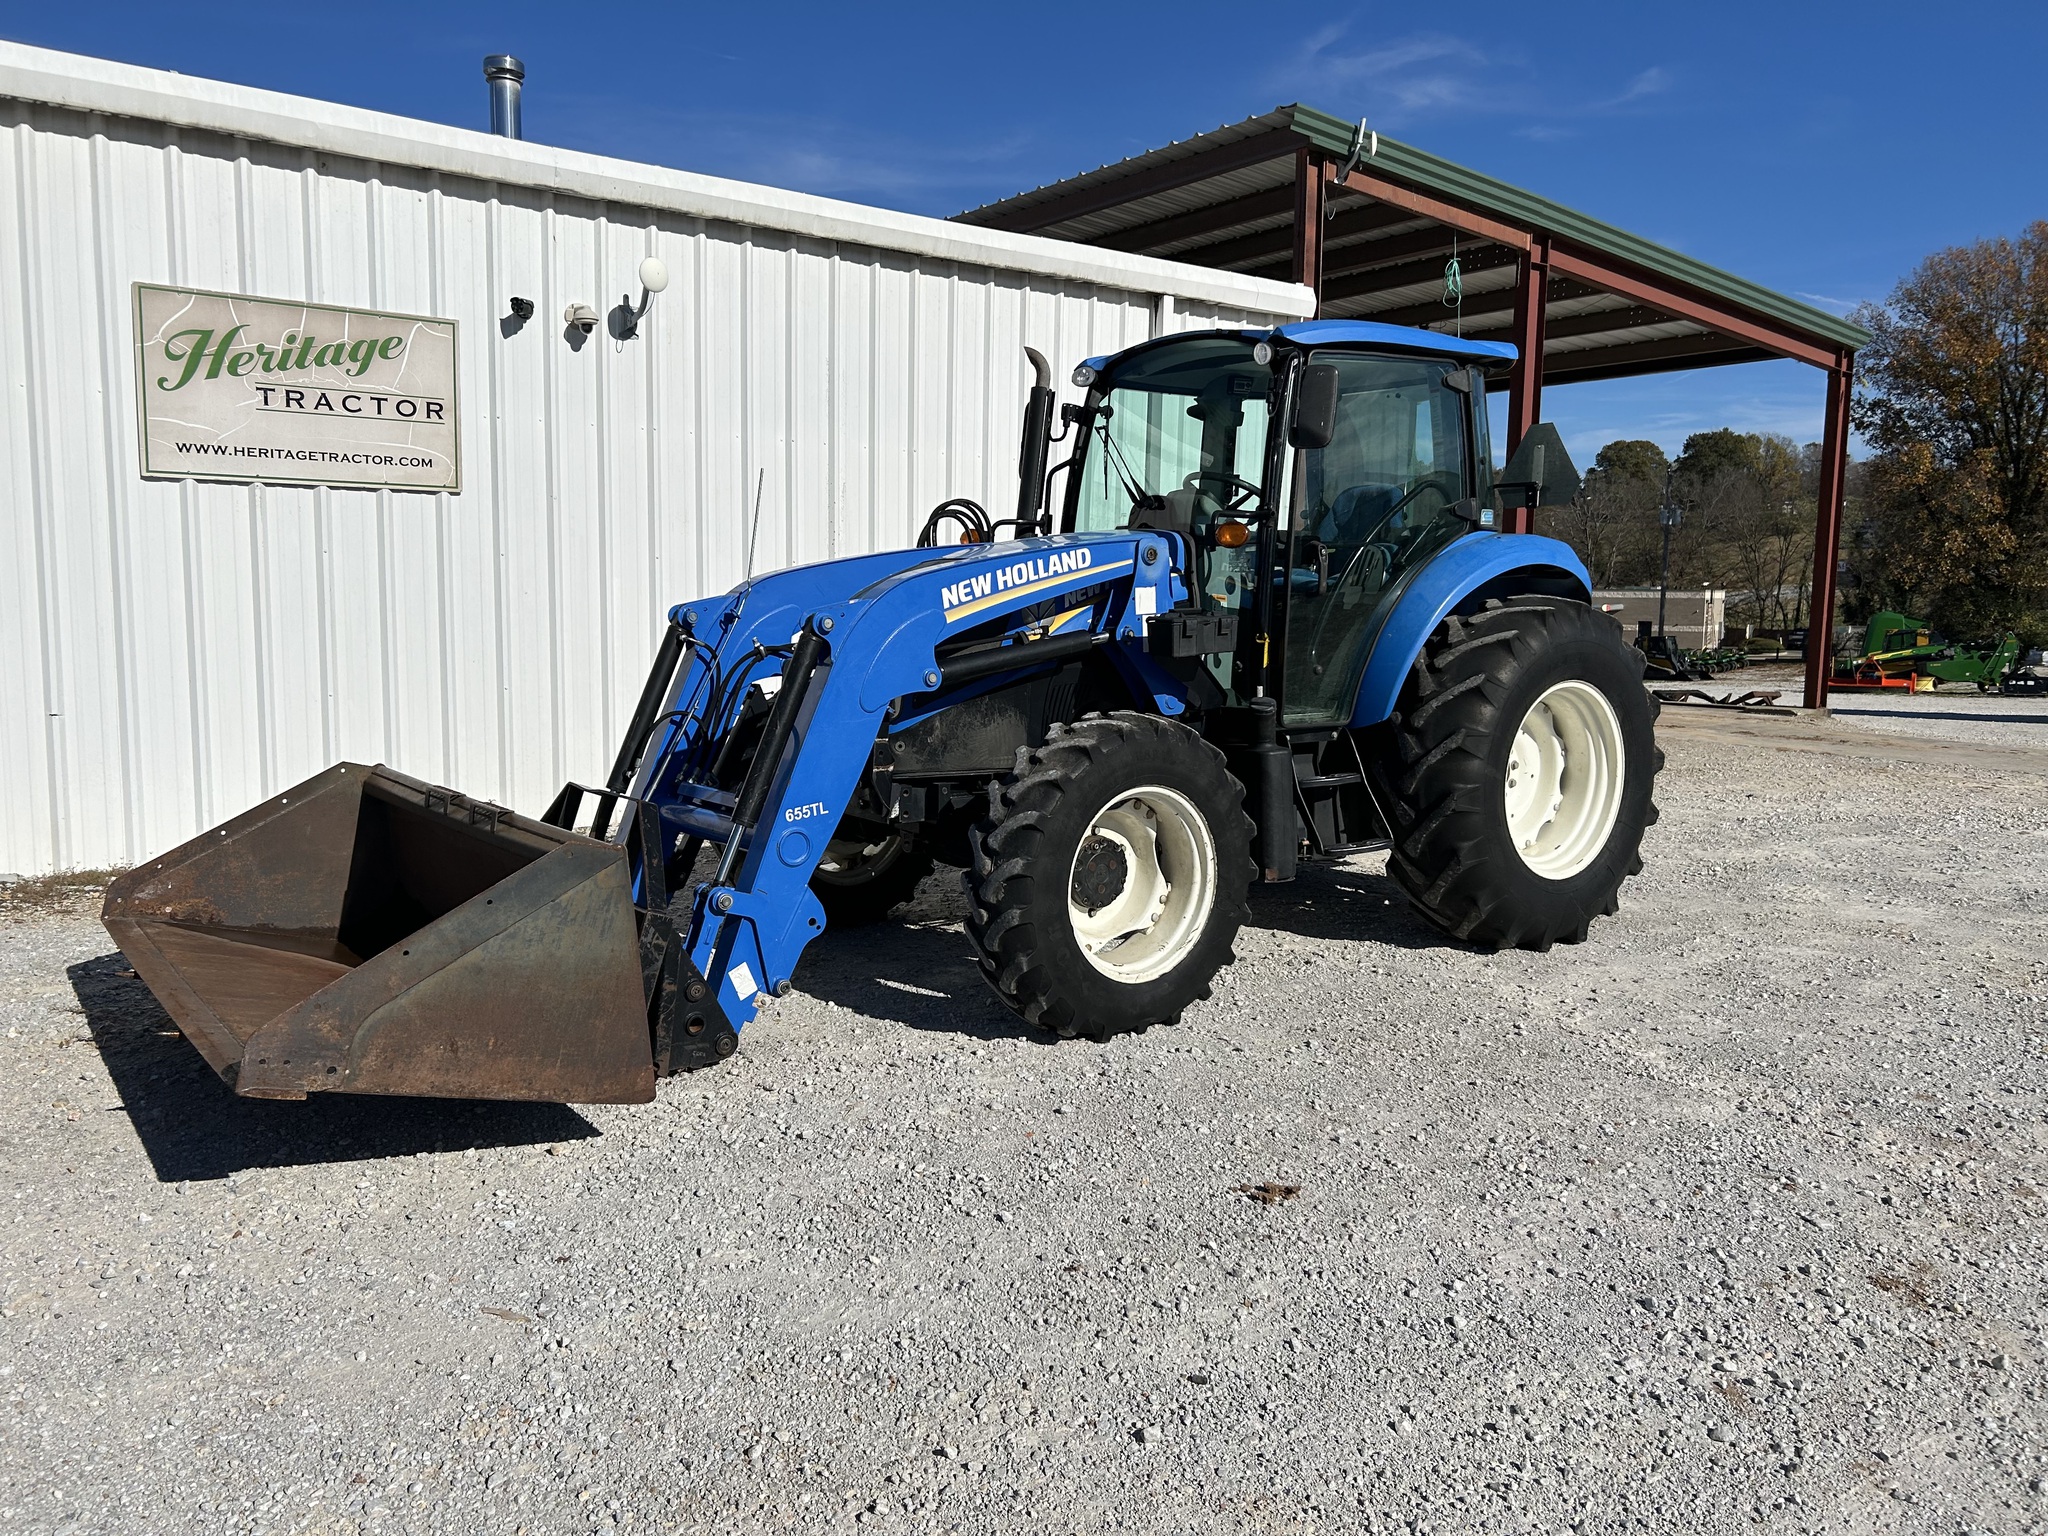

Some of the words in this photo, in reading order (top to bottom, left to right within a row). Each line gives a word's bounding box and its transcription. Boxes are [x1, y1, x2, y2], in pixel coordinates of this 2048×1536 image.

[157, 324, 408, 391] Heritage
[256, 386, 445, 420] TRACTOR
[176, 442, 433, 469] WWW.HERITAGETRACTOR.COM
[941, 572, 992, 609] NEW
[996, 547, 1092, 591] HOLLAND
[785, 801, 829, 822] 655TL
